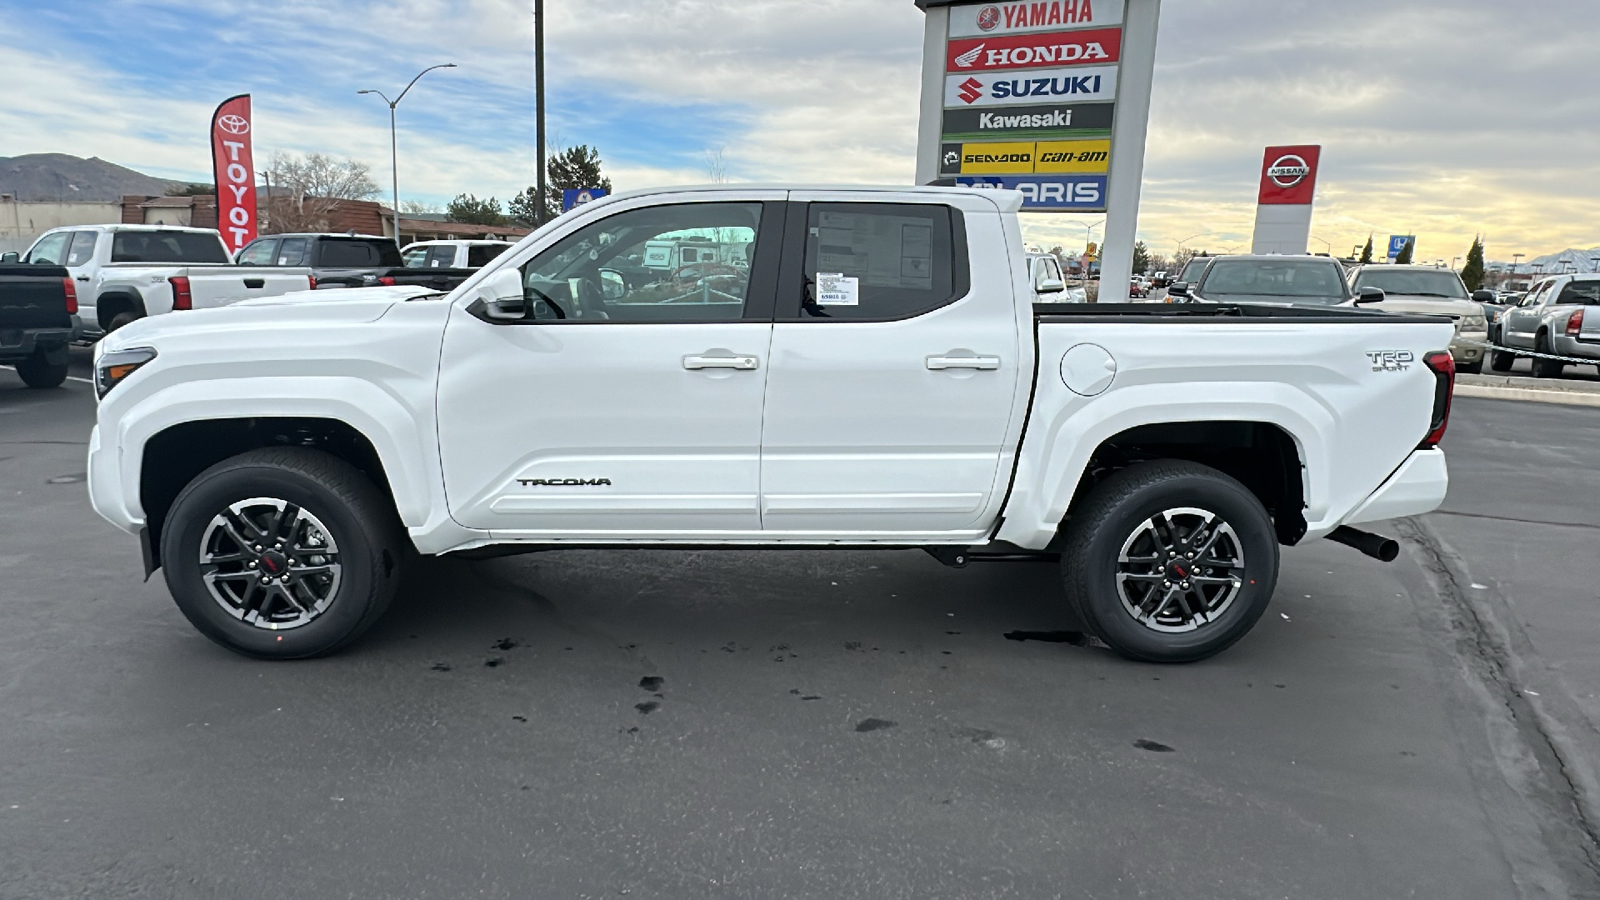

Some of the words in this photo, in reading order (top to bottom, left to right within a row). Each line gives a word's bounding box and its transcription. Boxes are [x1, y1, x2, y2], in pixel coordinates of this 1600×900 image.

[1003, 0, 1092, 29] YAMAHA
[985, 42, 1108, 66] HONDA
[991, 75, 1101, 98] SUZUKI
[979, 109, 1072, 129] Kawasaki
[1365, 350, 1414, 366] TRD
[516, 478, 611, 486] TACOMA
